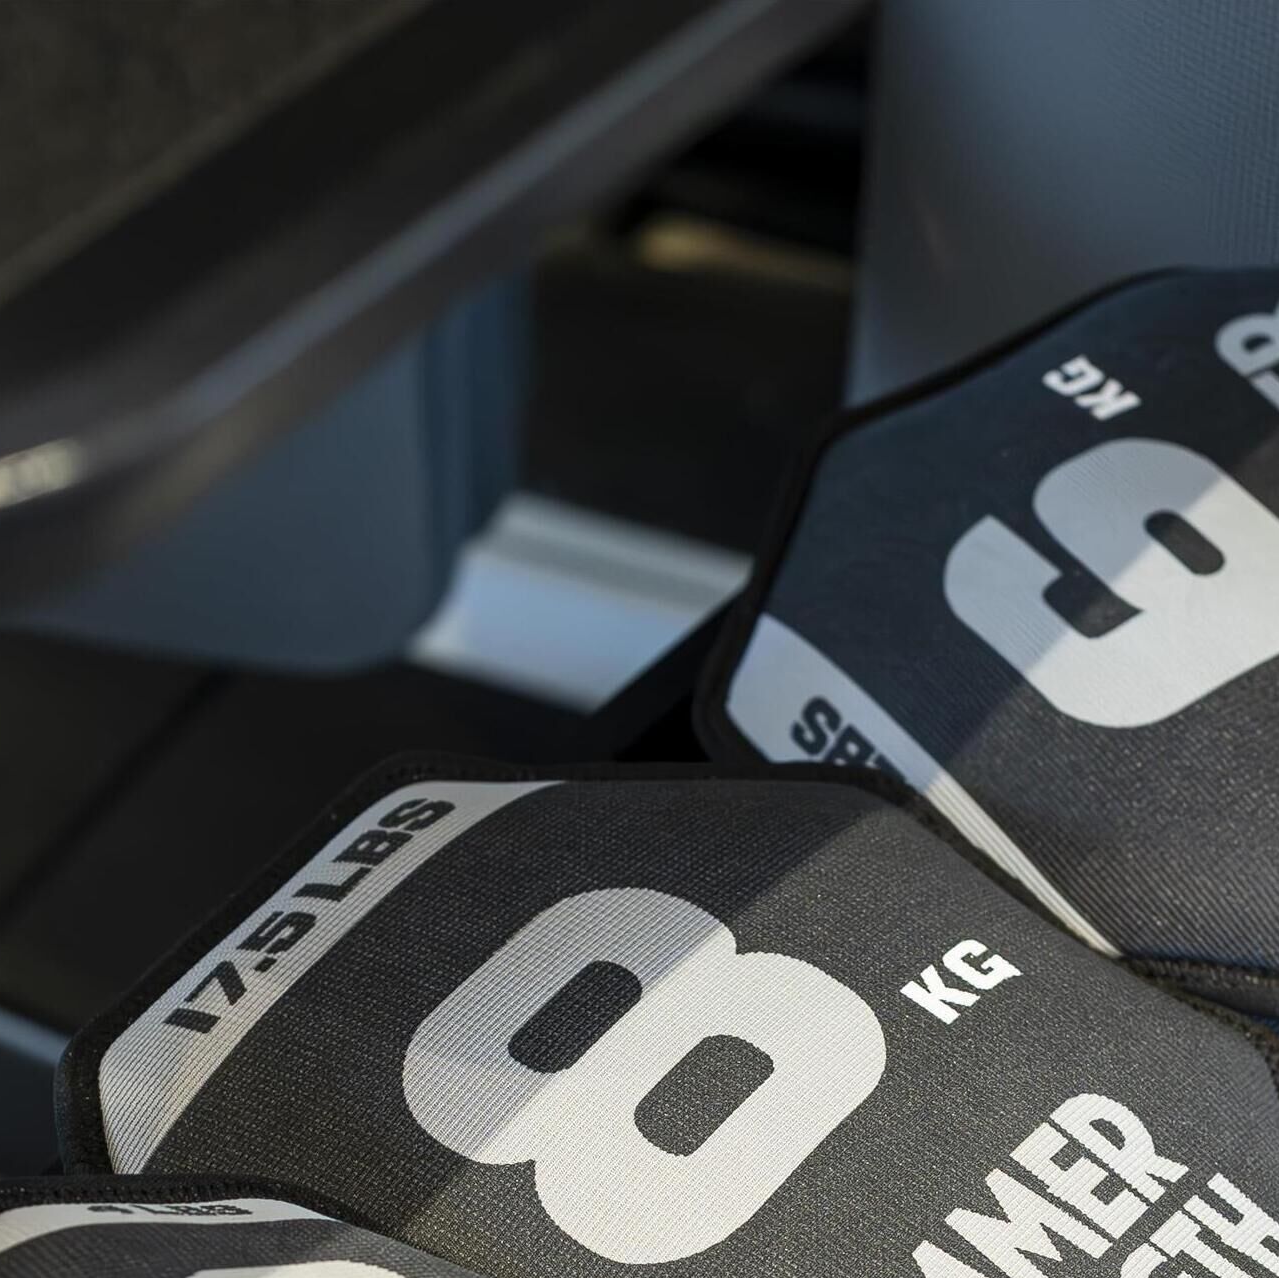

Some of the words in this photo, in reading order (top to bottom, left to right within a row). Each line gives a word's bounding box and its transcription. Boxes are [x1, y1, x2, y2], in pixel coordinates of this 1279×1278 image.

[1041, 355, 1140, 421] KG
[162, 911, 317, 1034] 17.5
[291, 798, 456, 902] LBS
[403, 887, 887, 1264] 8
[900, 939, 1022, 1024] KG
